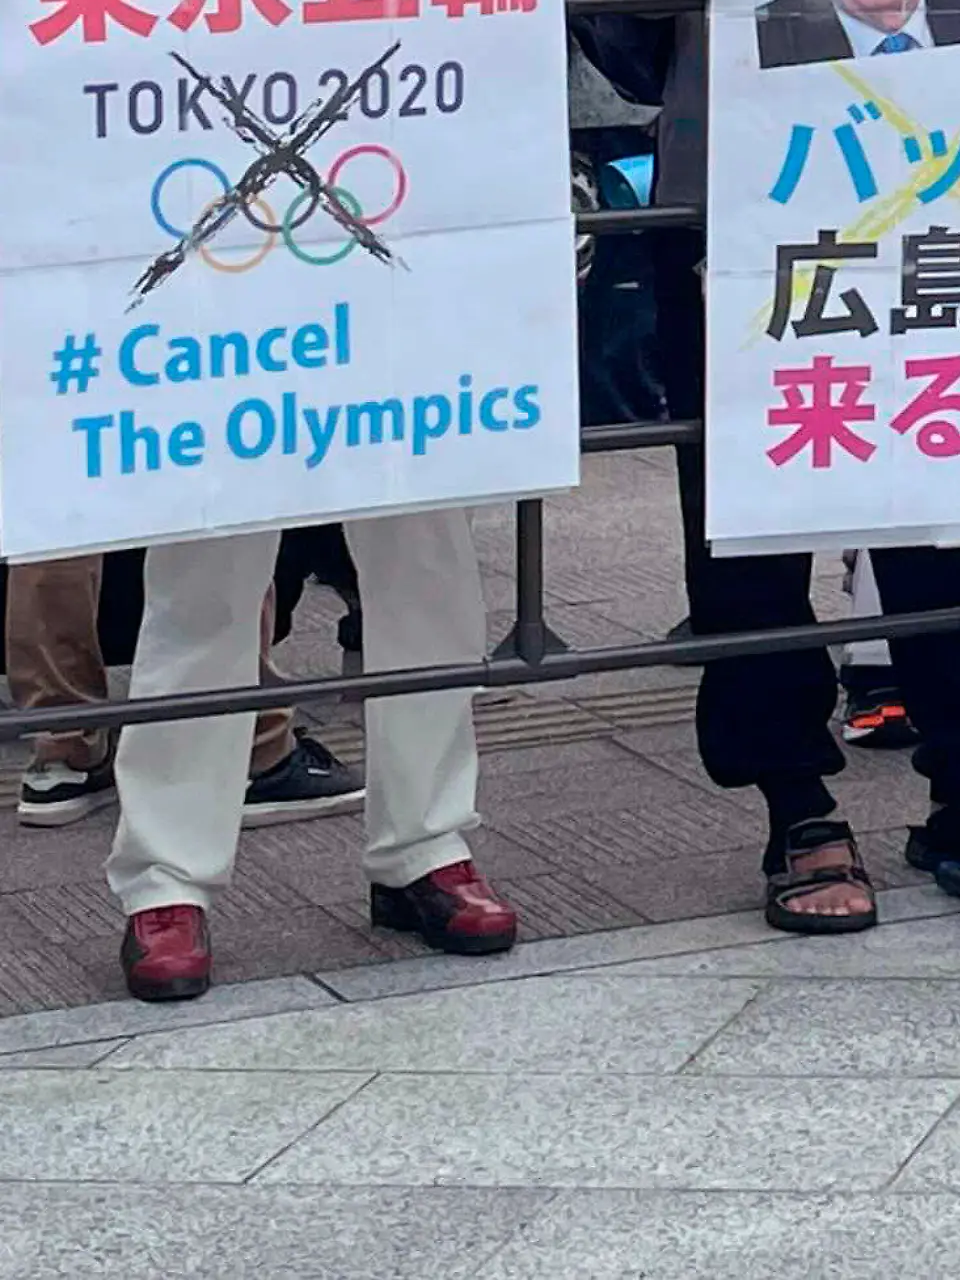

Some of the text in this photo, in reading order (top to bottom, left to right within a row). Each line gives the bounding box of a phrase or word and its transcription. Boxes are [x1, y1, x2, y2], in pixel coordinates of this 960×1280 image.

[83, 60, 464, 138] TOKYO 2020
[118, 302, 350, 387] Cancel
[72, 374, 542, 478] The Olympics
